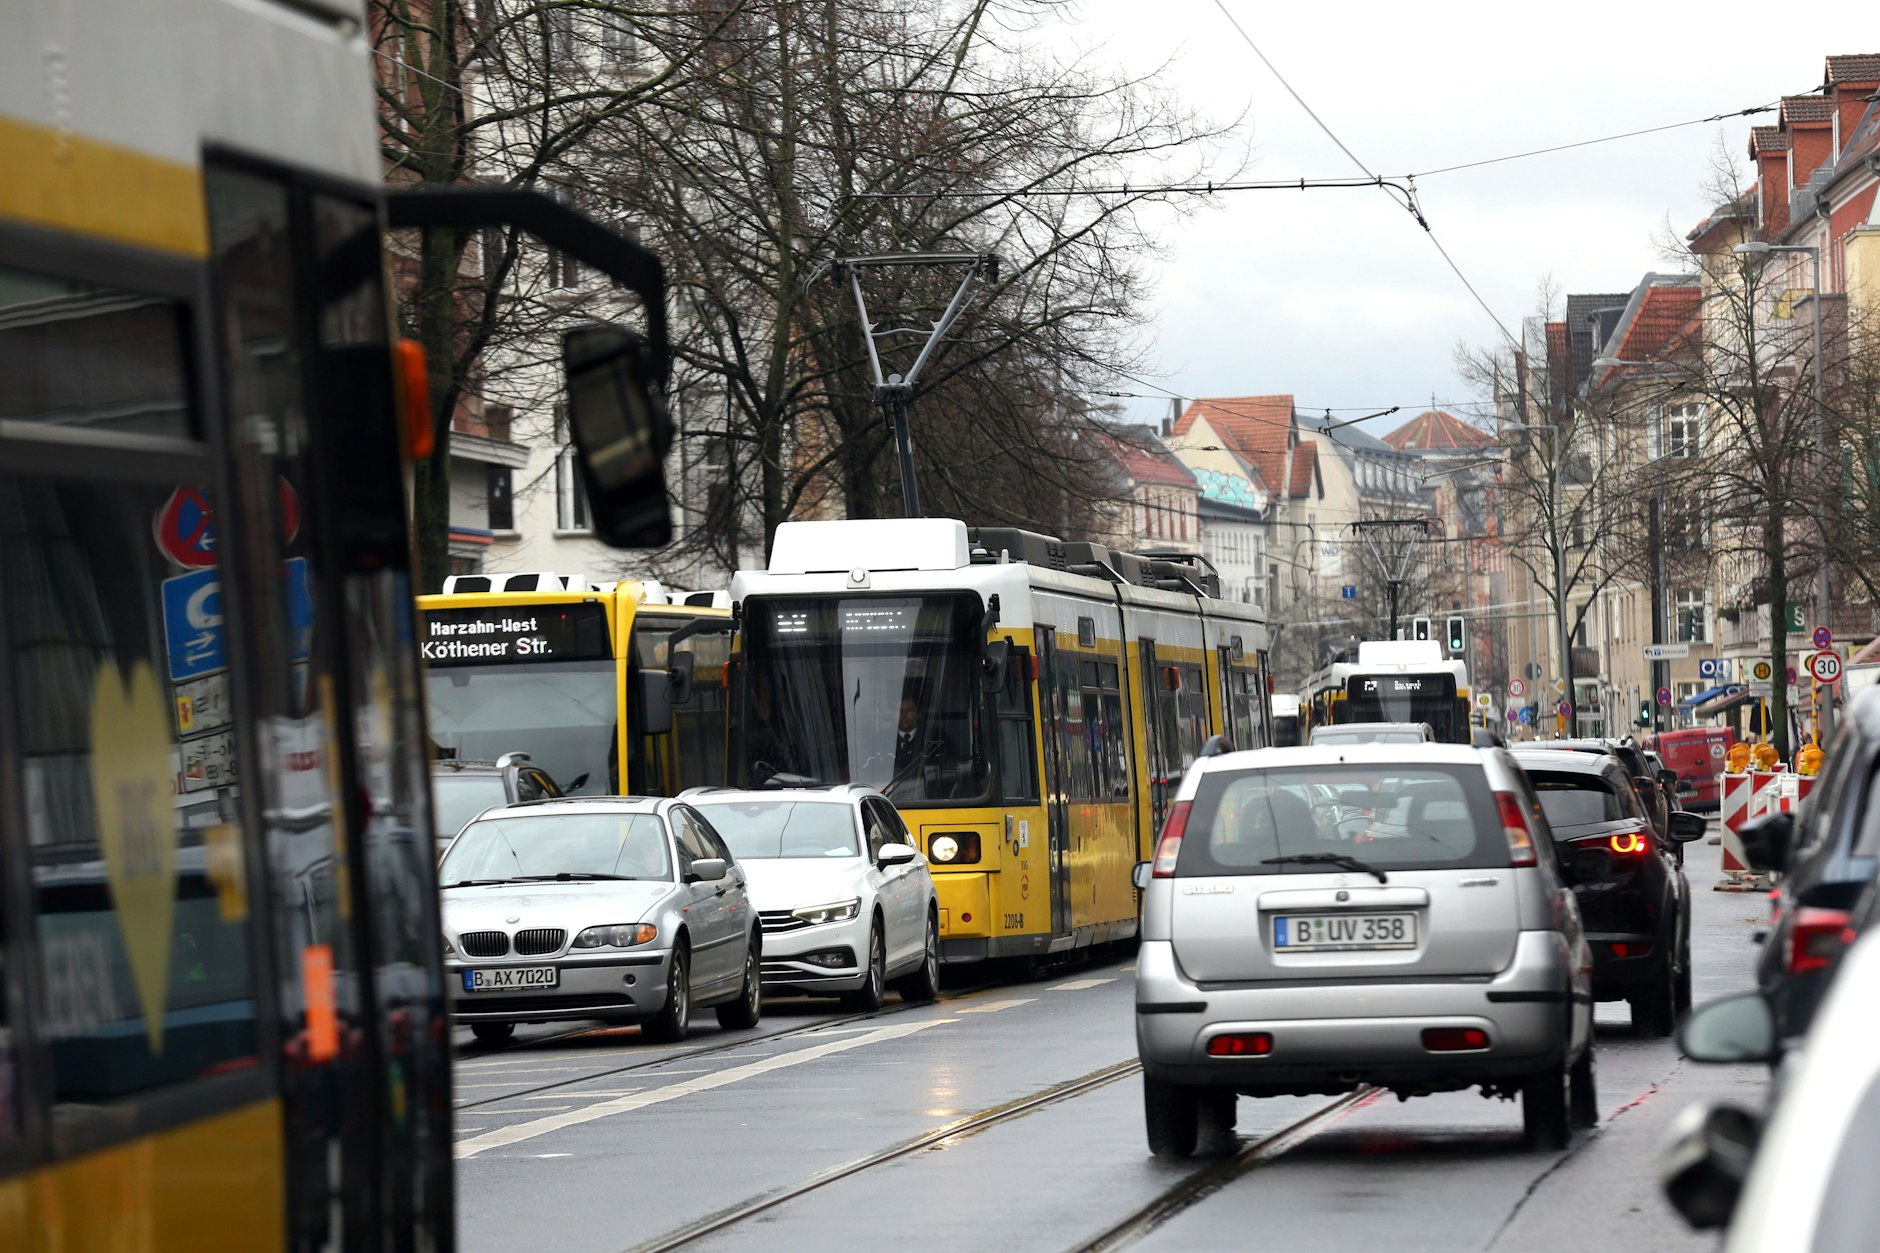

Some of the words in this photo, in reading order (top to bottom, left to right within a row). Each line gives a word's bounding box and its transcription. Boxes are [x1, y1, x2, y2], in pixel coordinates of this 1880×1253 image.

[430, 617, 538, 636] Marzahn-West
[421, 640, 509, 659] Köthener
[516, 637, 553, 655] Str.
[1758, 665, 1767, 676] H
[1817, 659, 1837, 675] 30
[1298, 920, 1311, 942] B
[1328, 919, 1357, 941] UV
[1363, 918, 1405, 940] 358
[474, 972, 484, 986] B
[494, 971, 513, 985] AX
[516, 968, 553, 985] 7020
